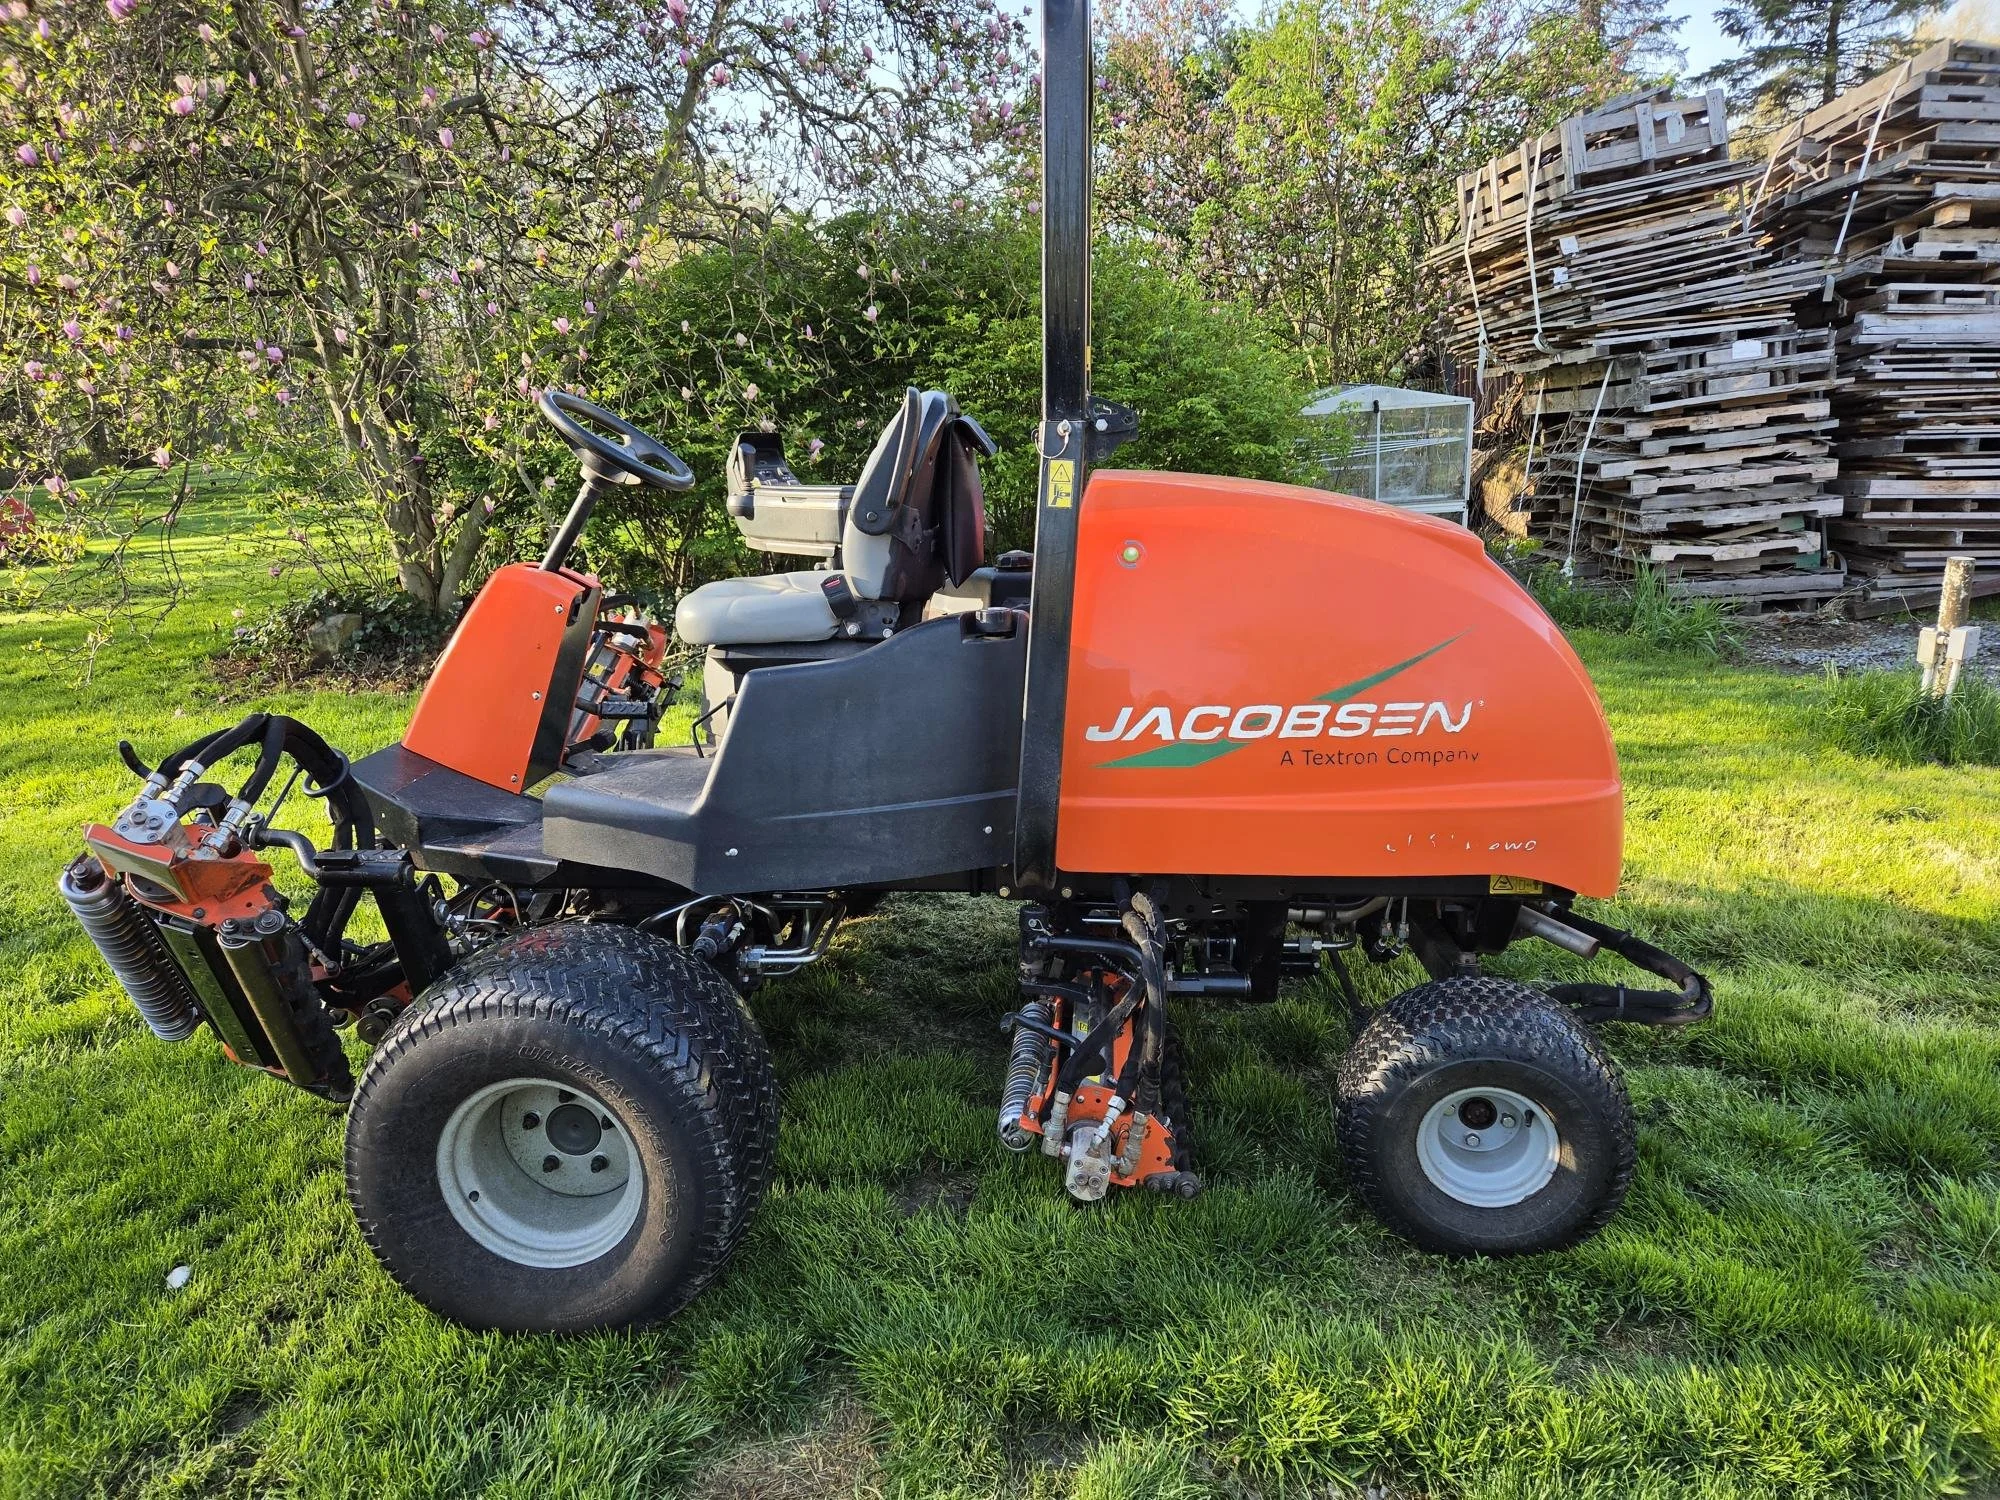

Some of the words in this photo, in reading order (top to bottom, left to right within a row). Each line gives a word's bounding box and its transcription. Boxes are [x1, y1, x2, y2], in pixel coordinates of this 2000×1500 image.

[1085, 701, 1473, 742] JACOBSEN
[1280, 750, 1294, 766] A
[1301, 749, 1378, 766] Textron
